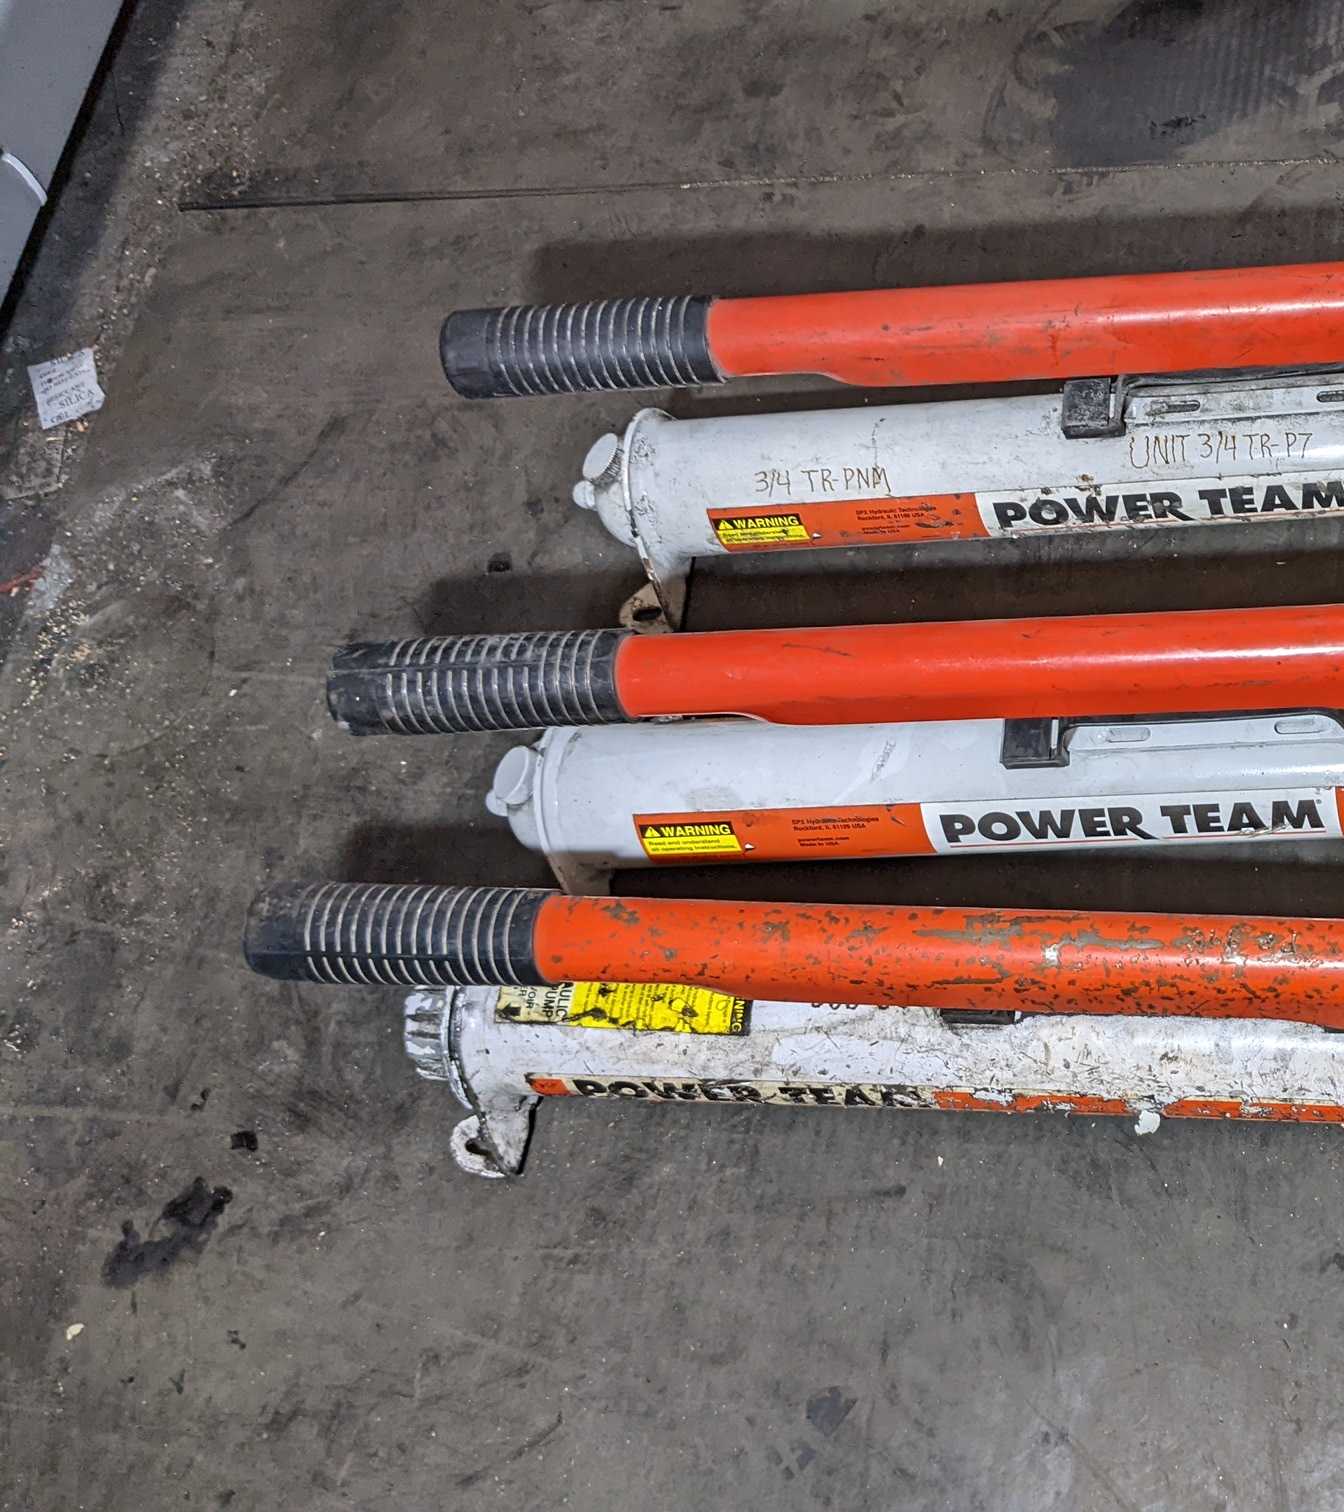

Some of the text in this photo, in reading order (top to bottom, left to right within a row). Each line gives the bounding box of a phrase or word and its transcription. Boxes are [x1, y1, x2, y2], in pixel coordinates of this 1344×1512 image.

[1129, 433, 1190, 469] UNIT
[1198, 431, 1238, 464] 3/4
[754, 469, 791, 498] 3/4
[733, 515, 799, 529] WARNING
[993, 491, 1195, 528] POWER
[660, 824, 731, 837] WARNING
[938, 799, 1325, 843] POWER TEAM
[731, 997, 746, 1033] NING
